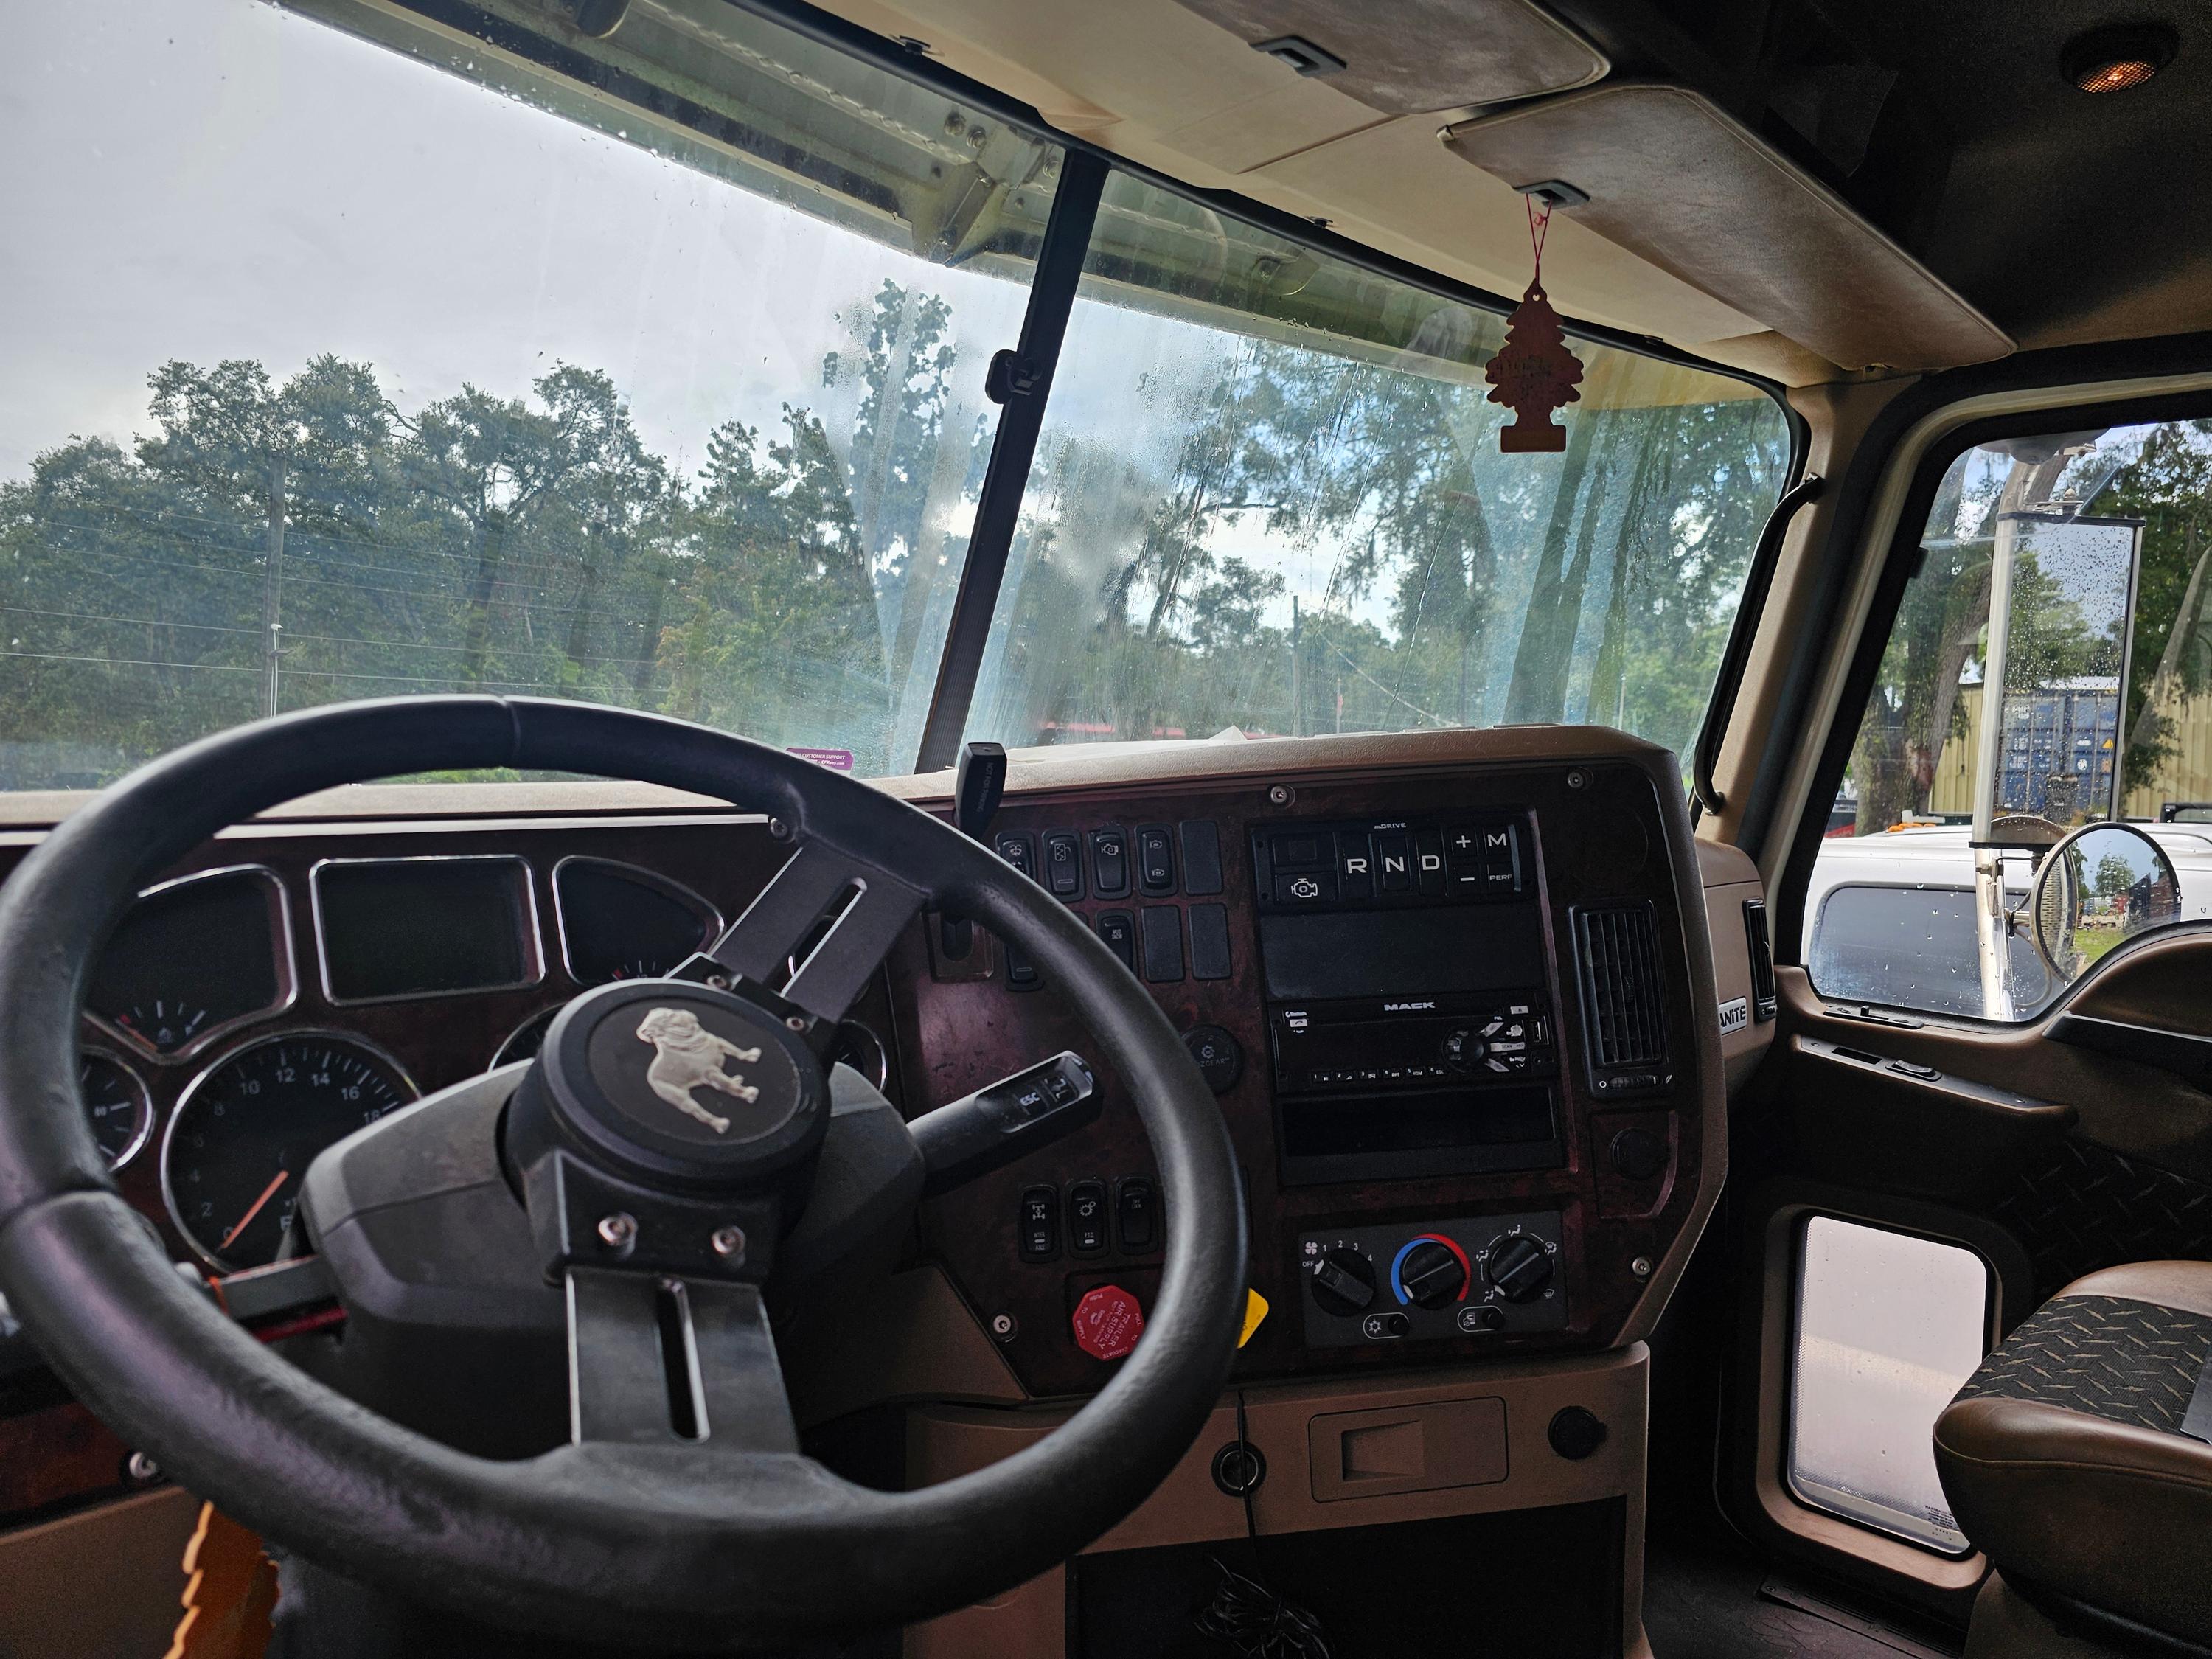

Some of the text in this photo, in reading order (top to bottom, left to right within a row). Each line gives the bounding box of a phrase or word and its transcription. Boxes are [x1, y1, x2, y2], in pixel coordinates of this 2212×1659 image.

[1486, 832, 1508, 847] M
[1346, 858, 1368, 874] R
[1385, 856, 1405, 872] N
[1421, 855, 1440, 871] D
[1383, 1001, 1436, 1012] MACK
[276, 1068, 296, 1083] 12
[310, 1073, 330, 1087] 14
[240, 1079, 260, 1095] 10
[341, 1086, 361, 1101] 16
[1020, 1092, 1040, 1106] ESC
[1338, 1239, 1343, 1248] 2
[1353, 1242, 1359, 1251] 3
[1367, 1253, 1373, 1262] 4
[1114, 1301, 1126, 1316] AIR
[1098, 1316, 1119, 1349] SUPPLY
[1108, 1313, 1132, 1347] TRAILER
